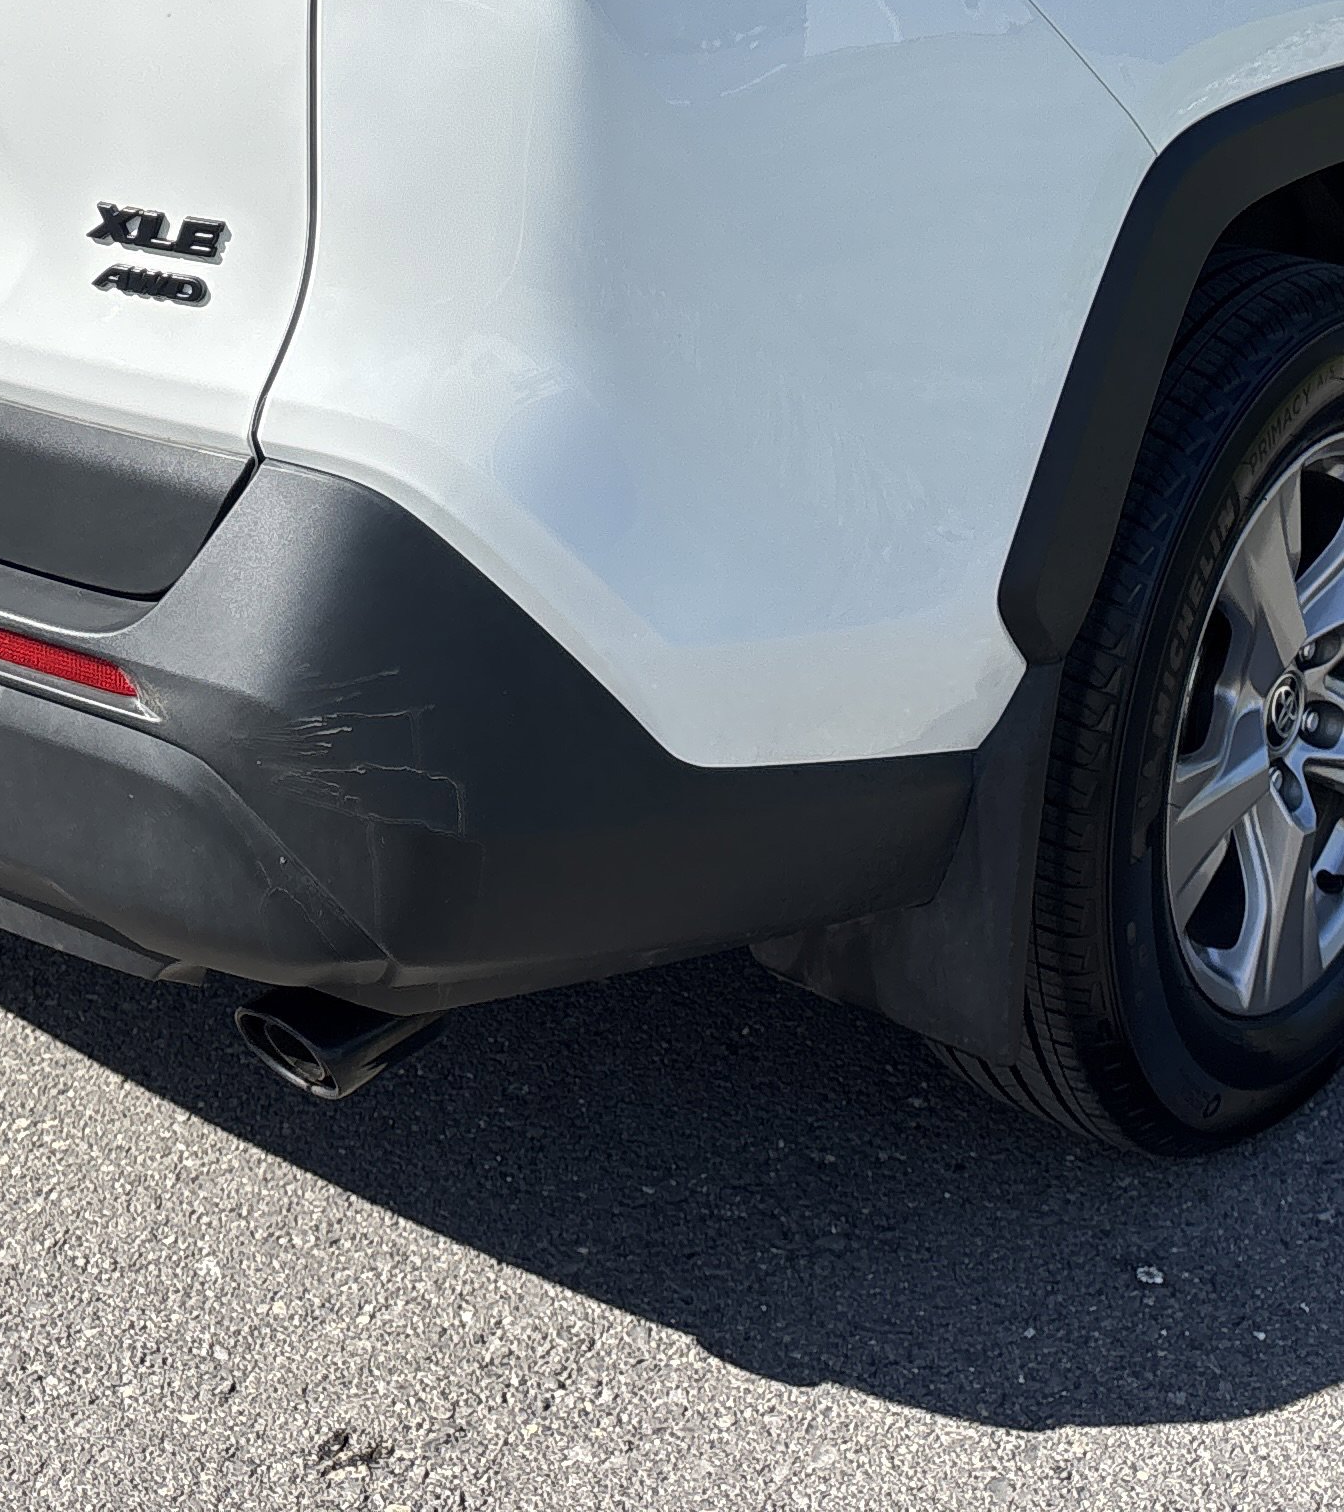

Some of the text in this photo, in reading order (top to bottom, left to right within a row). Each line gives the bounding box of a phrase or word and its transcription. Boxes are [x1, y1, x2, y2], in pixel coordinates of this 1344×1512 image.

[86, 200, 227, 257] XLE
[91, 263, 205, 302] AWD
[1243, 384, 1313, 475] PRIMACY
[1152, 496, 1241, 739] MICHELIN
